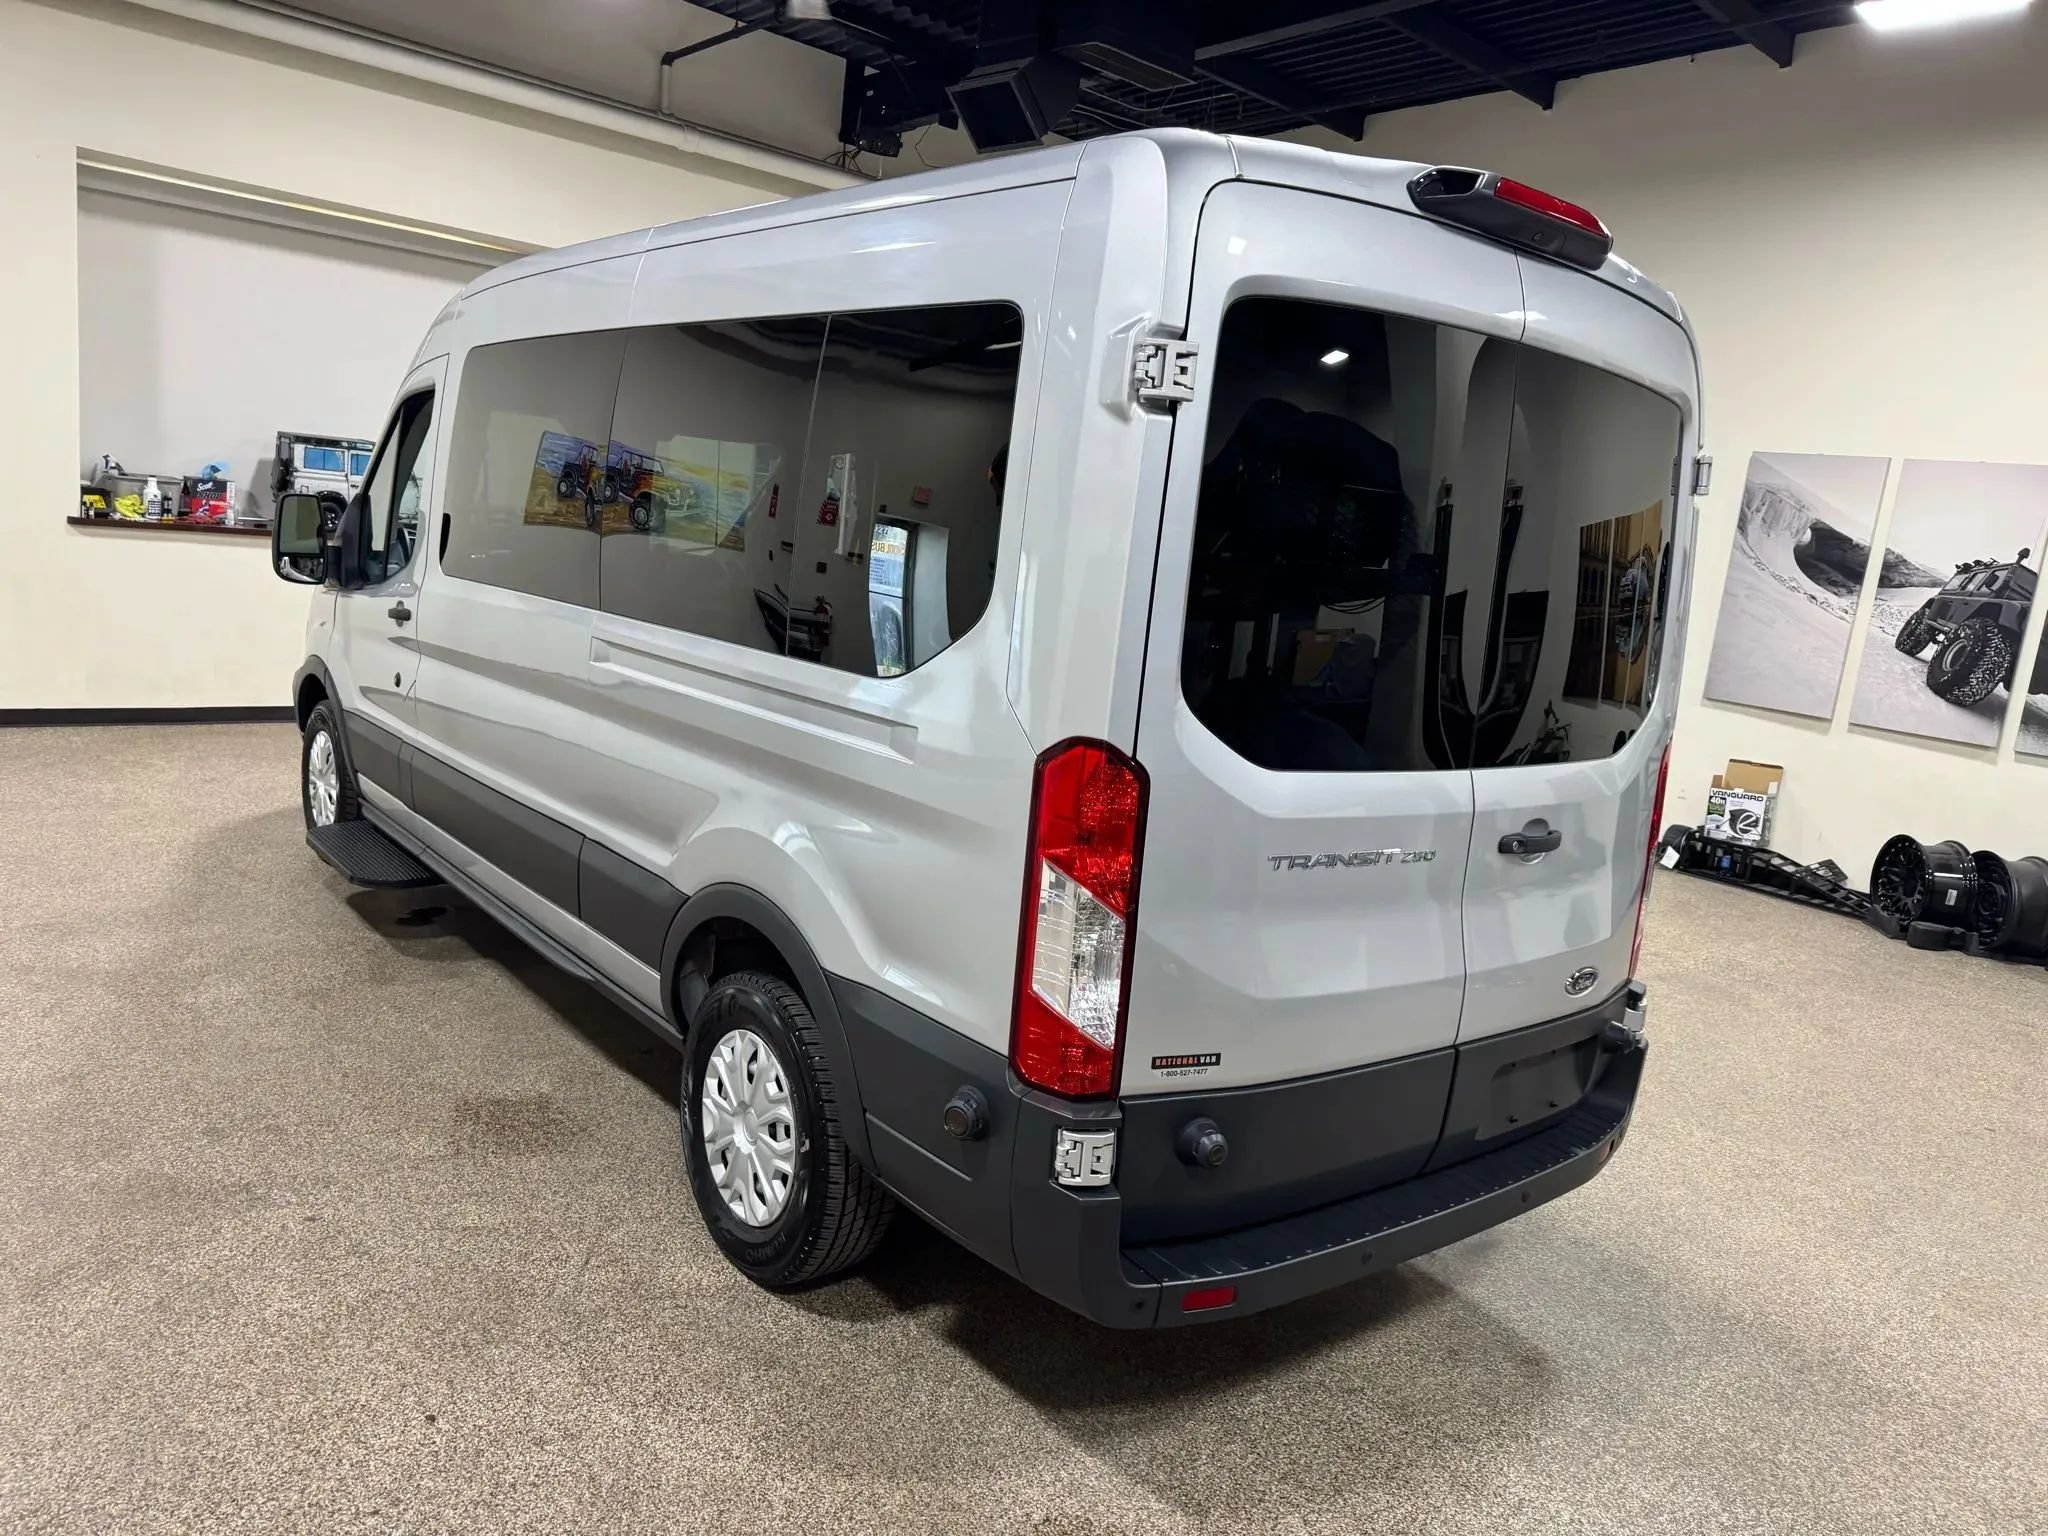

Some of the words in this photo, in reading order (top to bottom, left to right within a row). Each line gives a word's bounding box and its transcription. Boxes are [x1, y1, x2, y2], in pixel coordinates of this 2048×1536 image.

[1712, 790, 1764, 802] VANGUARD
[1268, 848, 1402, 872] TRANSIT
[1401, 849, 1437, 864] 250
[1155, 1056, 1198, 1066] NATIONAL
[1200, 1055, 1217, 1064] VAN
[1160, 1068, 1208, 1078] 1-800-527-7477
